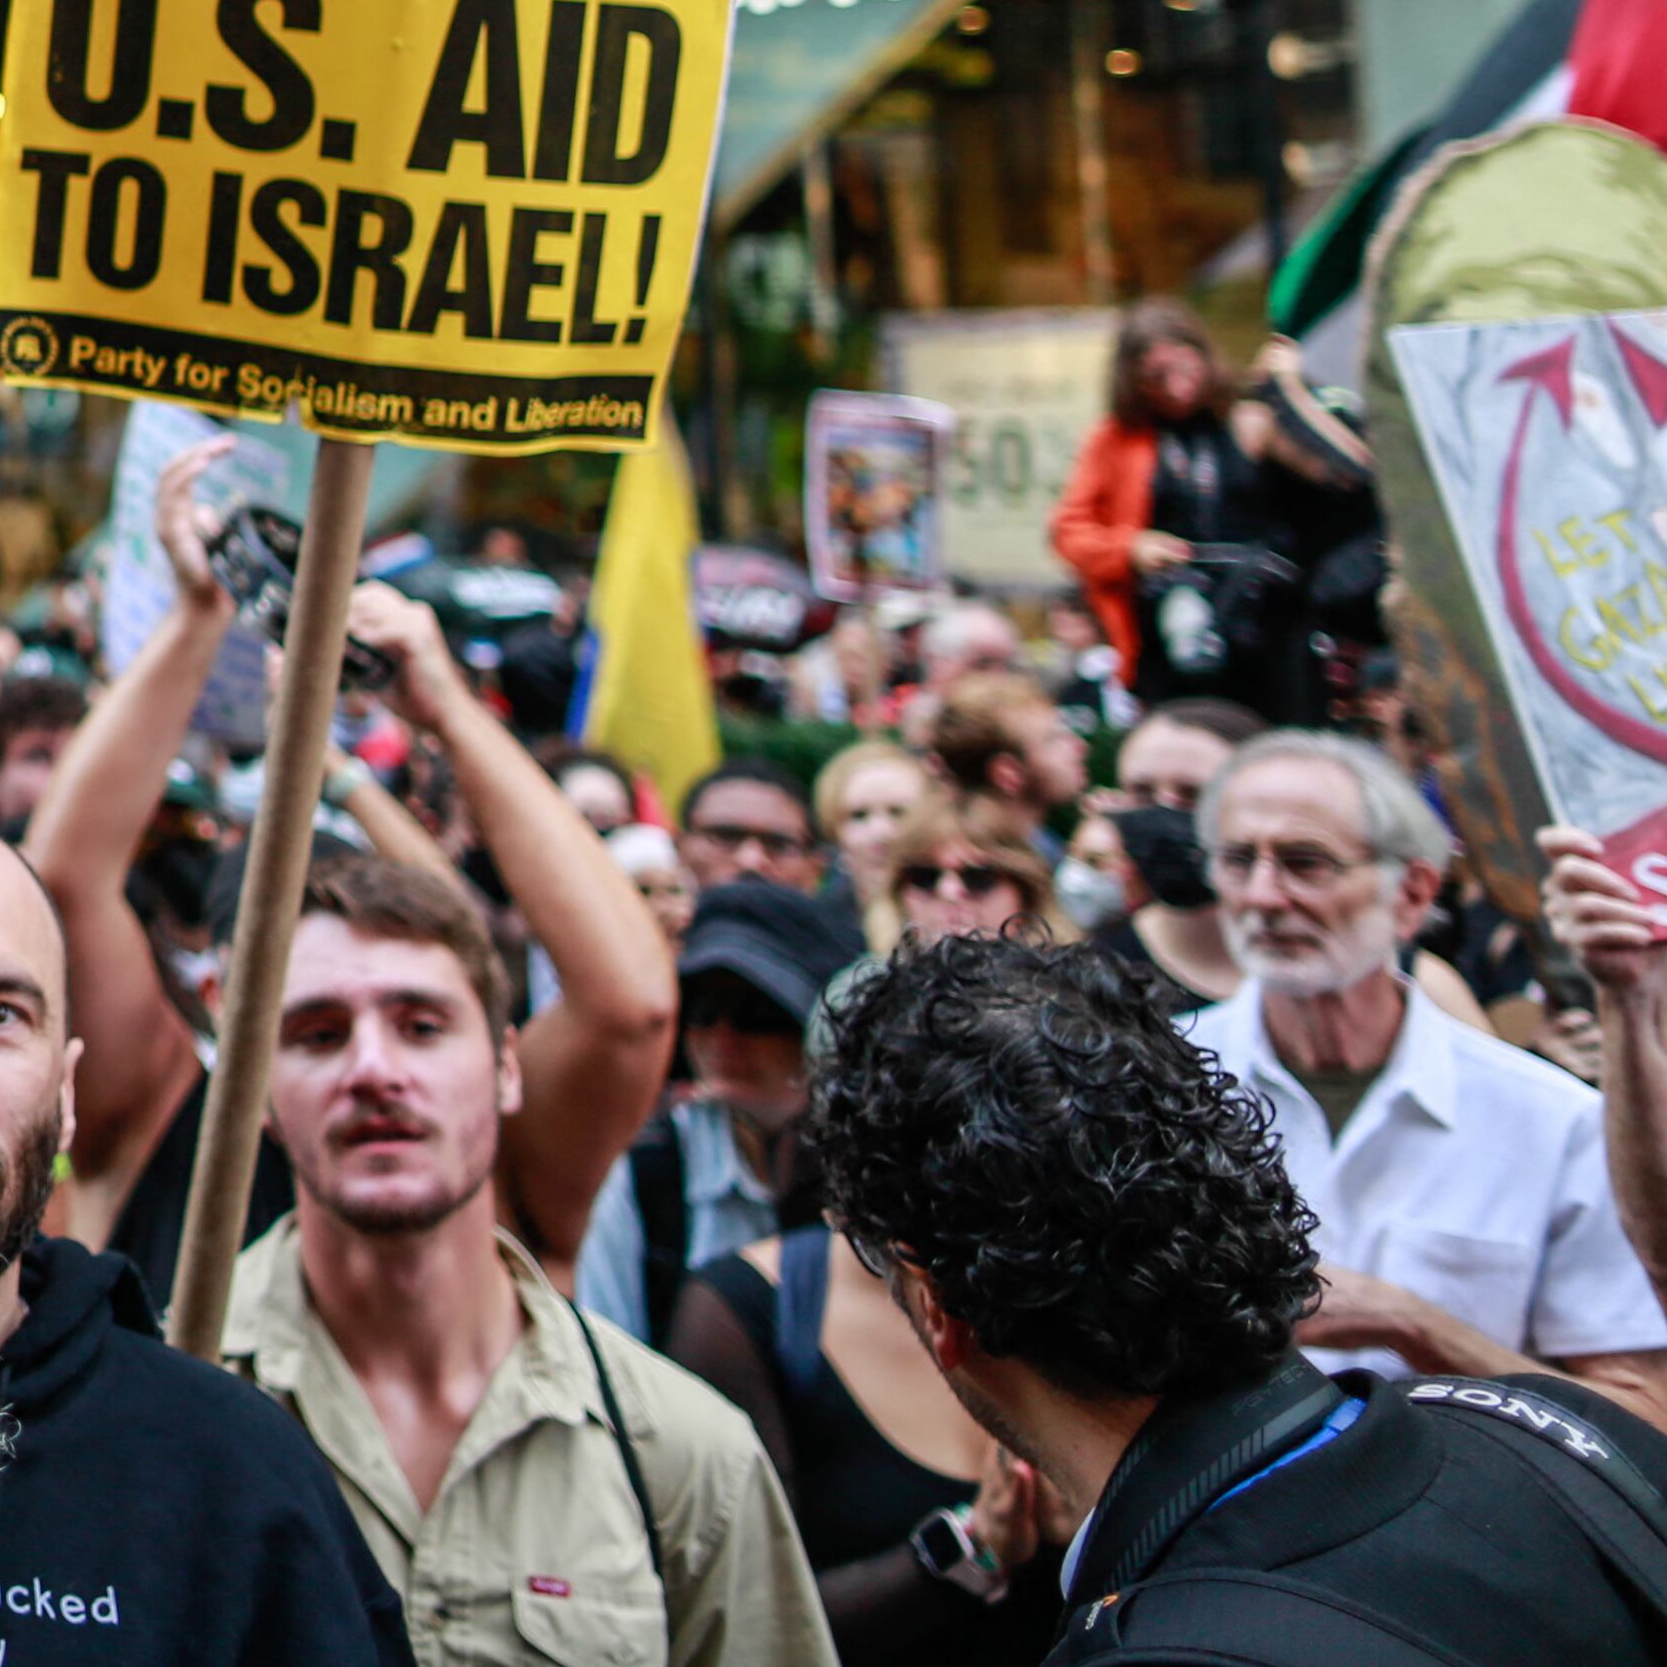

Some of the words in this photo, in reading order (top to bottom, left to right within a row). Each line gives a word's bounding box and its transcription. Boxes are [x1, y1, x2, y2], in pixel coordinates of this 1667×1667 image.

[20, 147, 167, 292] TO
[201, 171, 661, 346] ISRAEL!
[69, 337, 166, 386] Party
[174, 360, 229, 392] for
[236, 364, 413, 423] Socialism
[423, 396, 495, 432] and
[505, 394, 644, 433] Liberation
[1530, 508, 1639, 576] LET
[1408, 1383, 1610, 1461] SONY
